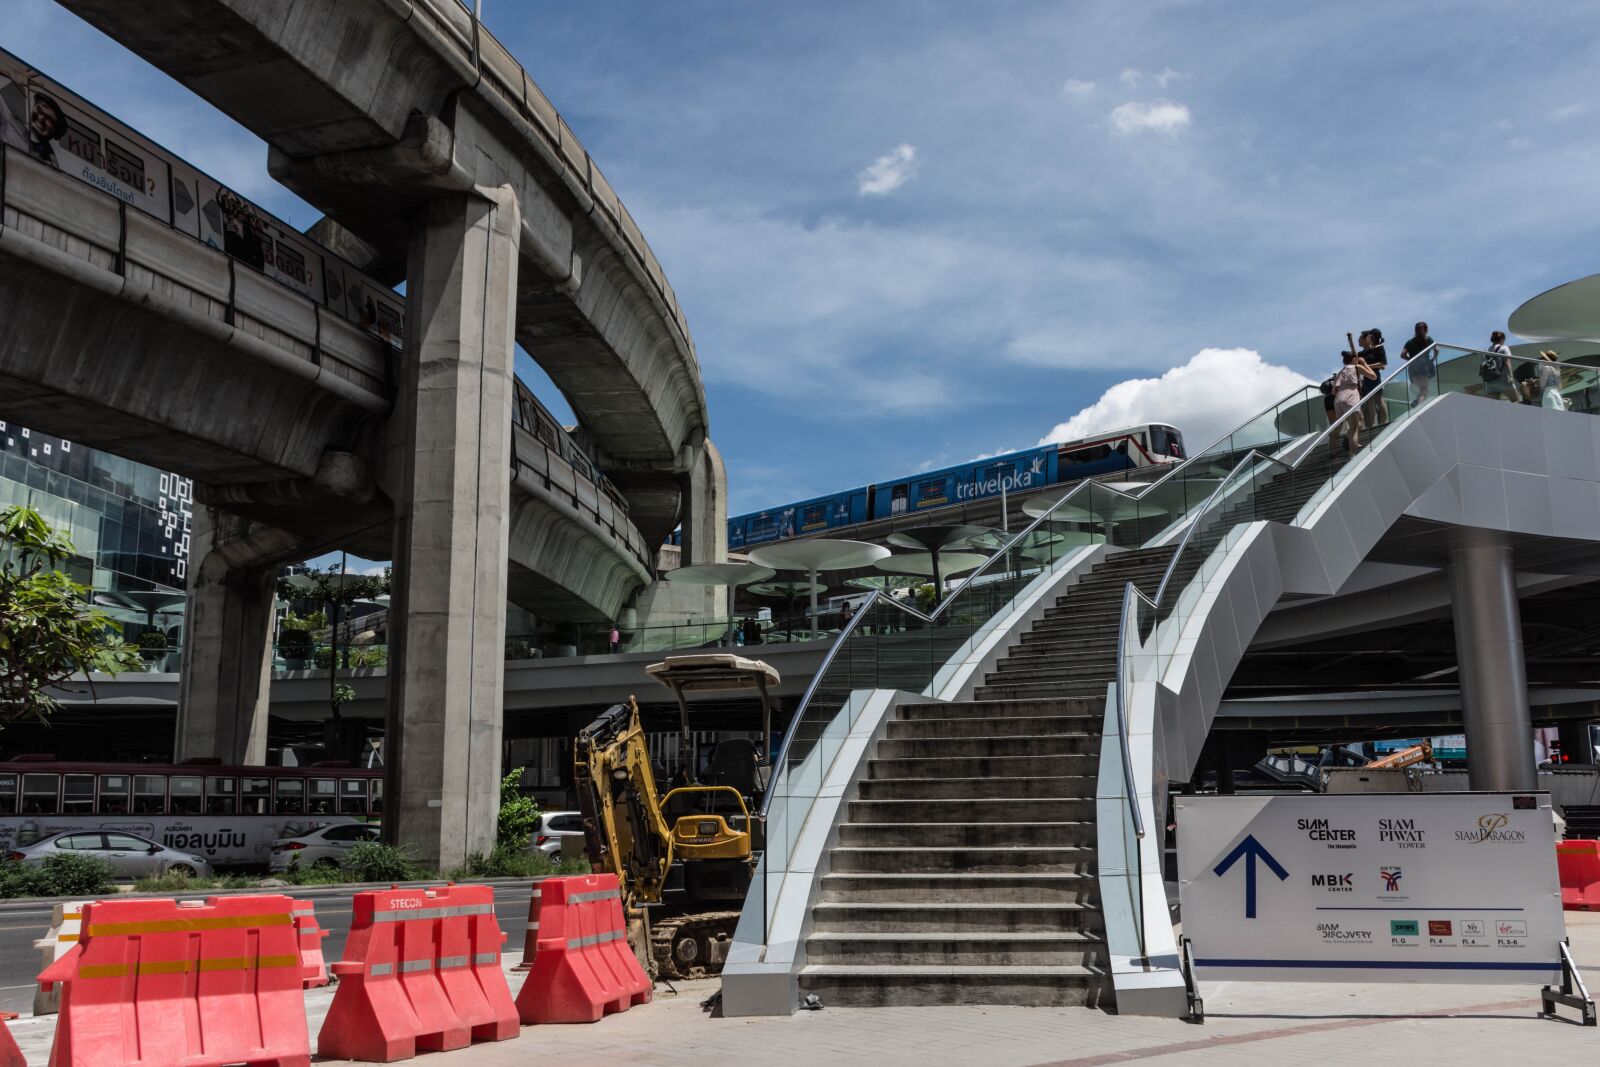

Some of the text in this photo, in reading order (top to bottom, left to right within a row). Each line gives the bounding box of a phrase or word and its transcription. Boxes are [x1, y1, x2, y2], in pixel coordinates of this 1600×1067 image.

[956, 469, 1032, 499] traveloka
[1297, 819, 1329, 830] SIAM
[1378, 819, 1414, 830] SIAM
[1309, 830, 1356, 841] CENTER
[1379, 830, 1425, 842] PIWAT
[1311, 873, 1354, 886] MBK
[390, 898, 422, 909] STECON
[1316, 923, 1339, 931] SIAM
[1322, 931, 1372, 939] DISCOVERY
